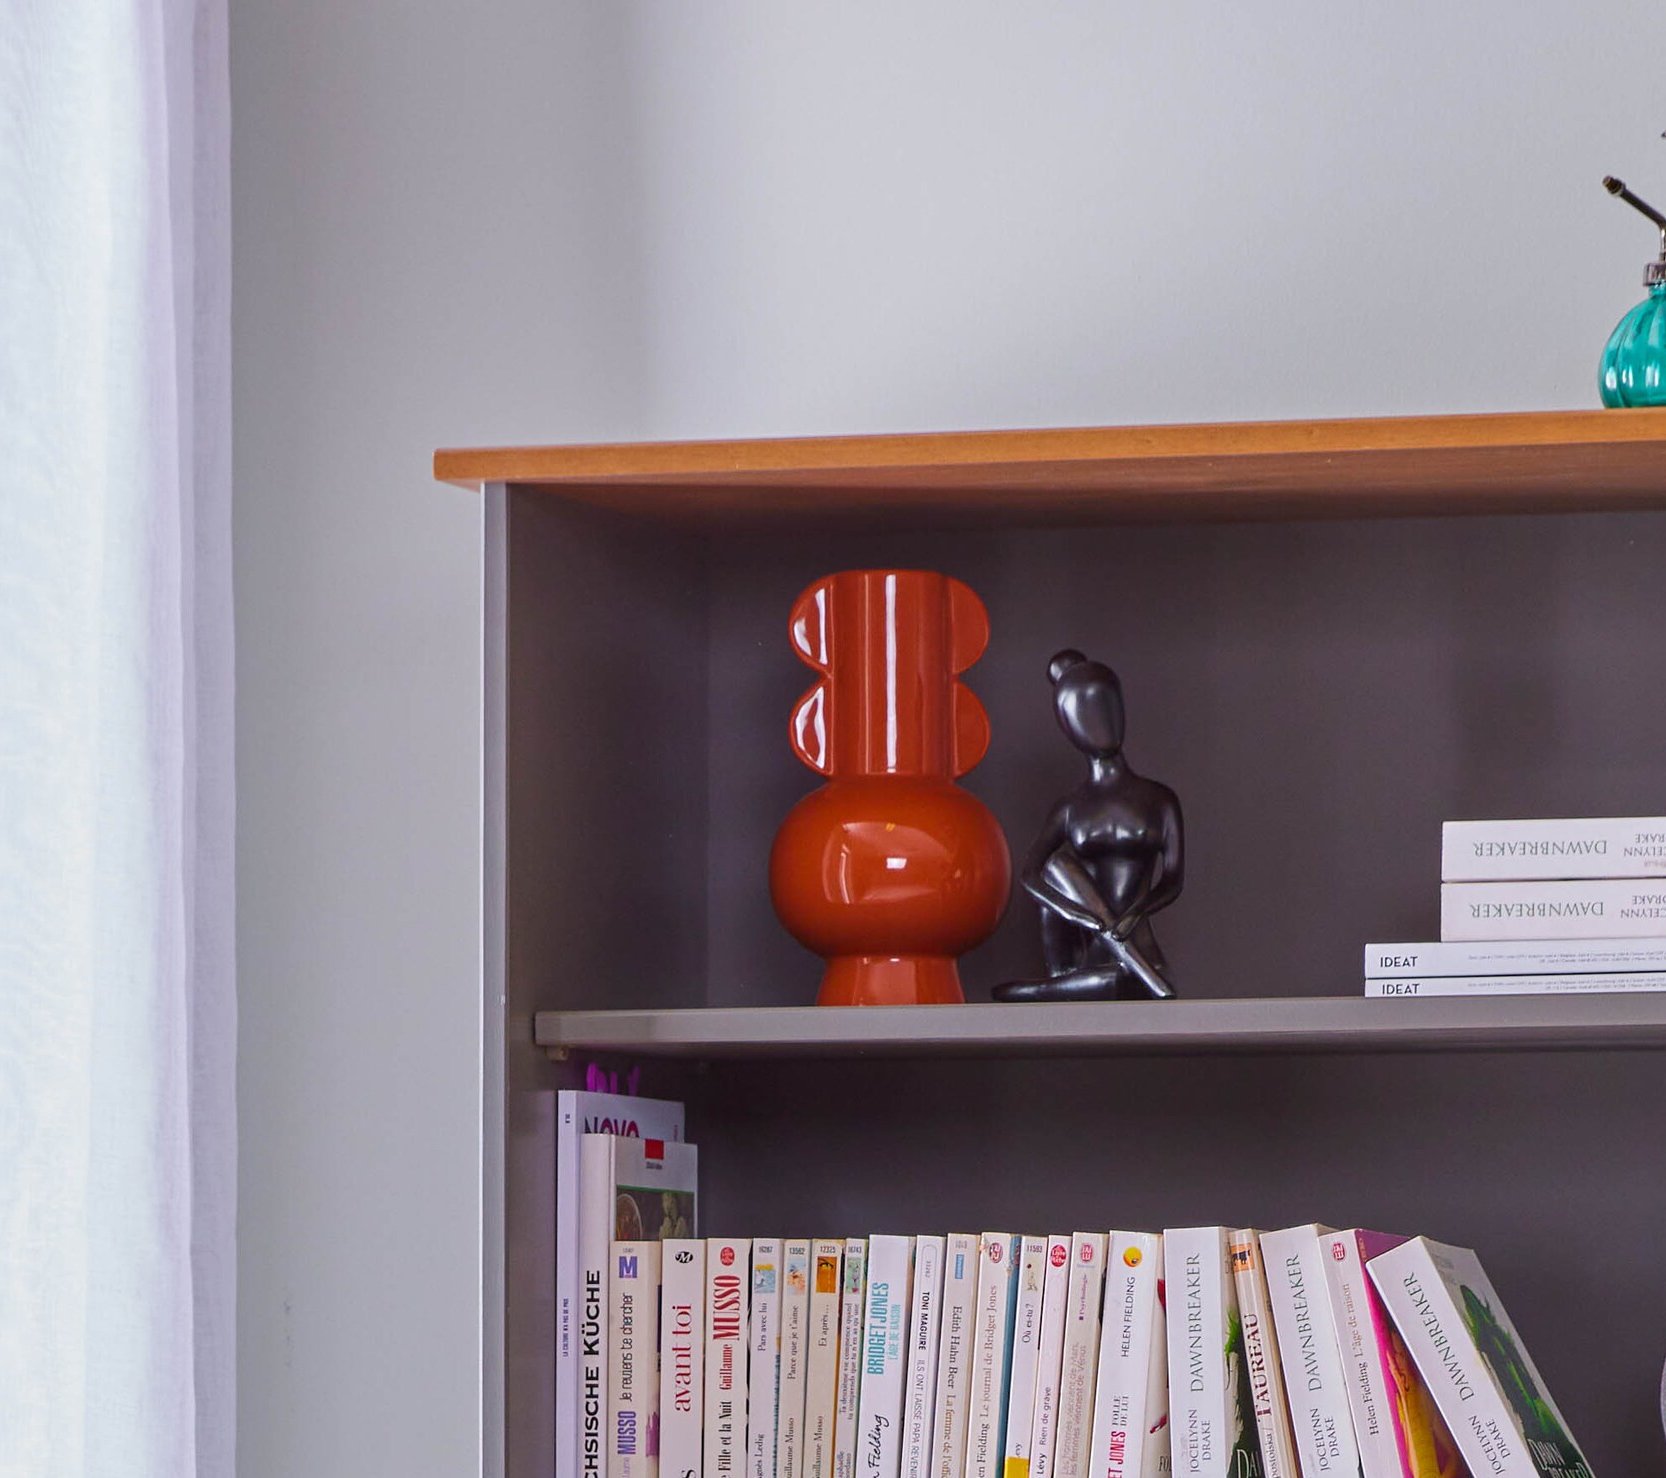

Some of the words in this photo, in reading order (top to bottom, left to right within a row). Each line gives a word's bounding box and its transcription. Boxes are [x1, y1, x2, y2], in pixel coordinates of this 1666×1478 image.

[1472, 840, 1608, 857] DAWNBREAKER
[1469, 901, 1604, 918] DAWNBREAKER
[1380, 956, 1418, 968] IDEAT
[1382, 983, 1420, 995] IDEAT
[581, 1270, 600, 1356] KÜCHE
[713, 1275, 741, 1340] MUSSO
[869, 1282, 889, 1322] JONES
[922, 1291, 930, 1311] TONI
[1124, 1277, 1136, 1322] FIELDING
[672, 1304, 691, 1336] toi
[918, 1313, 928, 1350] MAGUIRE
[952, 1306, 962, 1333] Edith
[1186, 1253, 1204, 1392] DAWNBREAKER
[1286, 1254, 1322, 1391] DAWNBREAKER
[1403, 1272, 1474, 1401] DAWNBREAKER
[867, 1324, 886, 1375] BRIDGET
[950, 1336, 960, 1363] Hahn
[1121, 1325, 1131, 1357] HELEN
[672, 1343, 691, 1412] avant
[719, 1344, 733, 1390] Guillaume
[947, 1365, 958, 1389] Beer
[718, 1424, 732, 1433] la
[719, 1401, 732, 1420] Nuit
[718, 1437, 731, 1446] et
[977, 1423, 989, 1462] Fielding
[1109, 1431, 1126, 1465] JONES
[1188, 1409, 1200, 1472] JOCELYNN
[1201, 1420, 1211, 1460] DRAKE
[1310, 1408, 1331, 1471] JOCELYNN
[1325, 1417, 1339, 1457] DRAKE
[1469, 1415, 1505, 1474] JOCELYNN
[1486, 1419, 1510, 1458] DRAKE
[718, 1449, 731, 1471] Fille
[1037, 1453, 1048, 1475] Lévy
